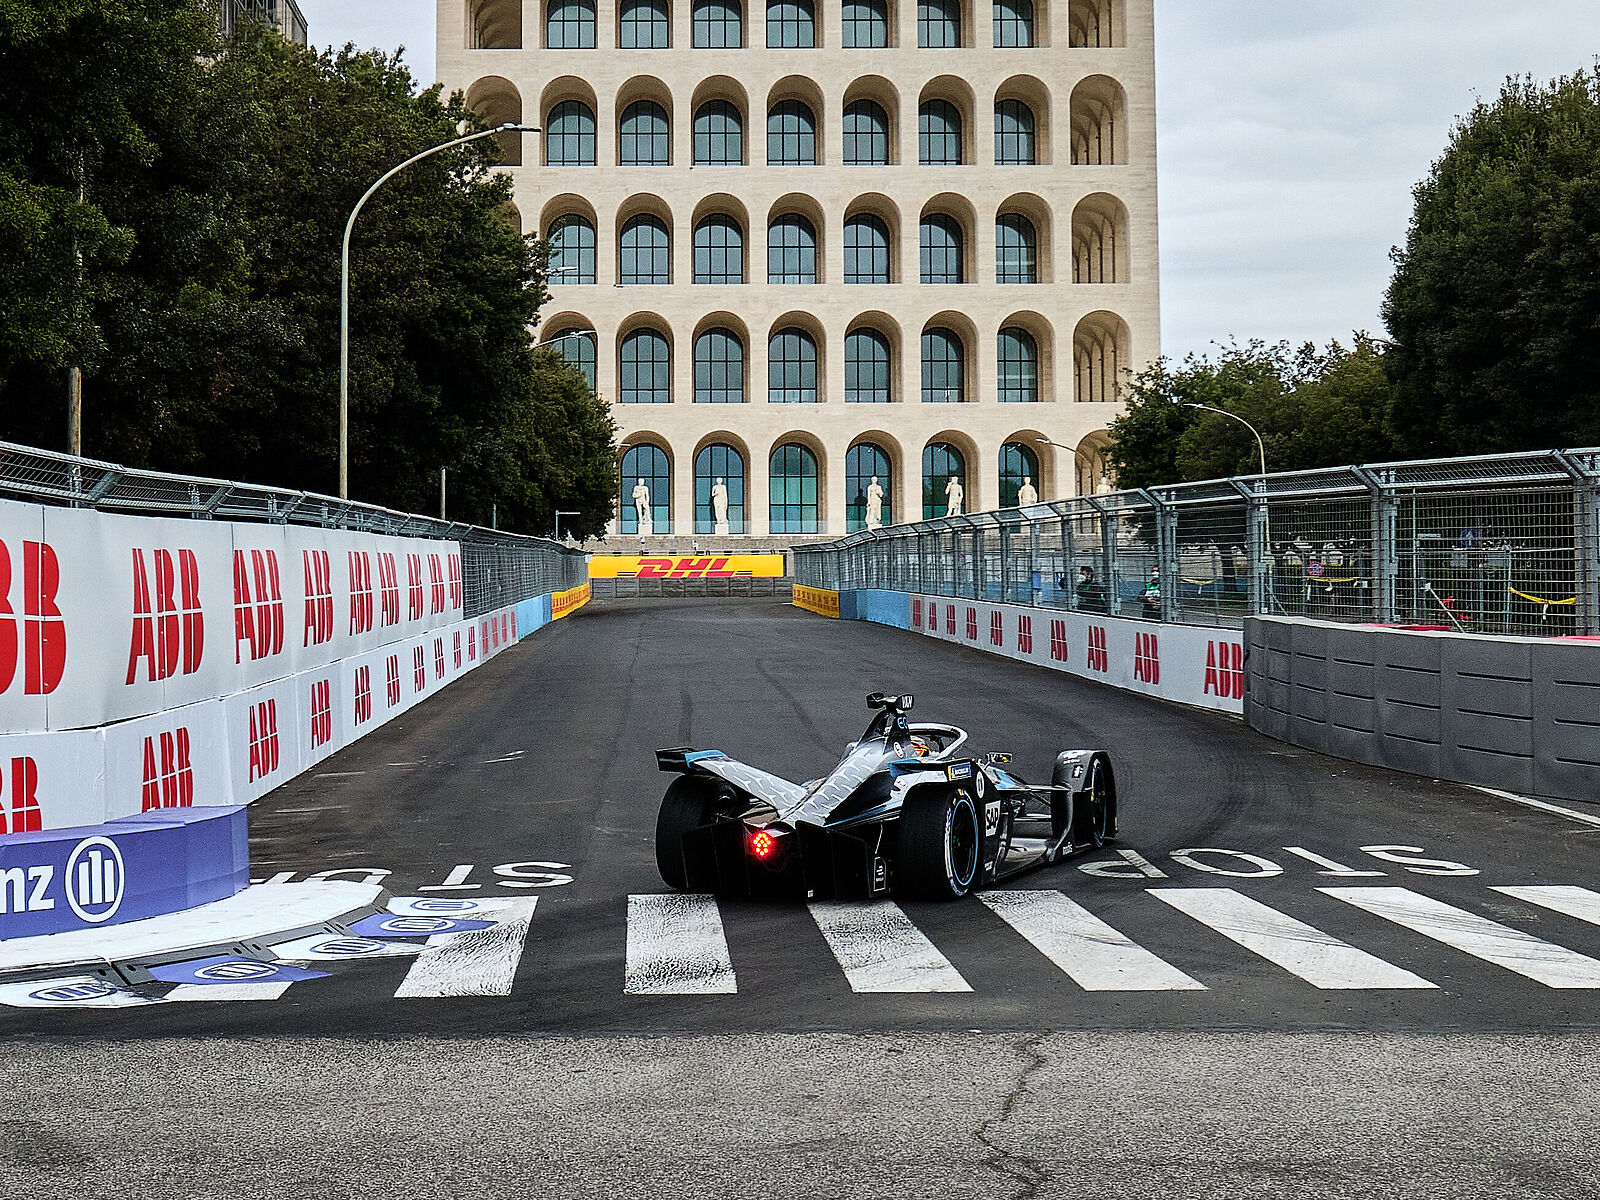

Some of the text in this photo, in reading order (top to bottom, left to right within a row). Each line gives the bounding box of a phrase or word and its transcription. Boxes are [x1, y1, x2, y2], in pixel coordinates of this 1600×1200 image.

[303, 550, 333, 647] ABB
[348, 552, 373, 636] ABB
[377, 553, 399, 627] ABB
[407, 554, 423, 621] ABB
[636, 558, 735, 577] DHL
[126, 548, 204, 685] ABB
[233, 550, 284, 664] ABB
[1051, 620, 1067, 662] ABB
[1088, 626, 1107, 672] ABB
[1134, 632, 1160, 684] ABB
[1204, 641, 1243, 699] ABB
[354, 666, 371, 726] ABB
[386, 655, 400, 707] ABB
[249, 699, 279, 783] ABB
[311, 680, 331, 749] ABB
[142, 727, 193, 812] ABB
[985, 807, 999, 830] SAP
[1077, 845, 1480, 879] STOP
